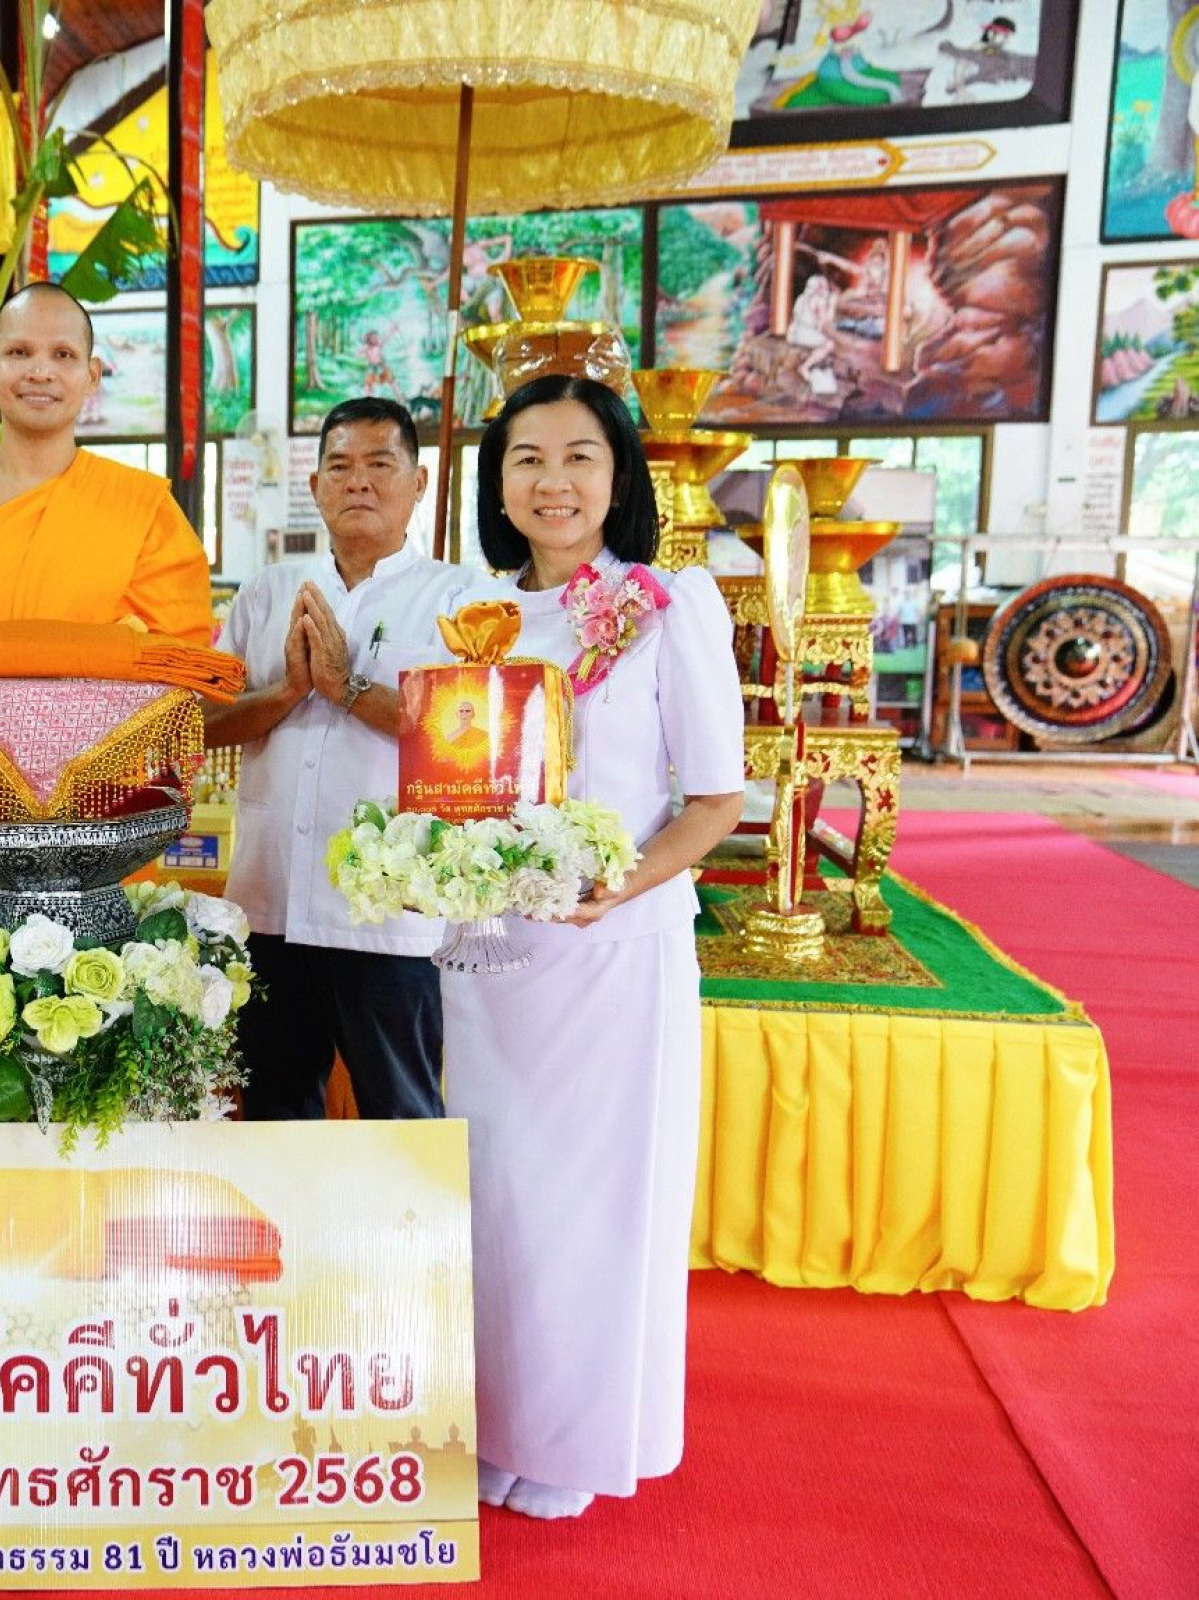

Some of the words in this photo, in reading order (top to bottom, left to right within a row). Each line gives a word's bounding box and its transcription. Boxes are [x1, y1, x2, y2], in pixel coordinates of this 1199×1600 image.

[279, 1456, 422, 1505] 2568
[104, 1545, 142, 1571] 81
[158, 1538, 179, 1570] ปี
[194, 1531, 455, 1571] หลวงพ่อธัมมชโย
